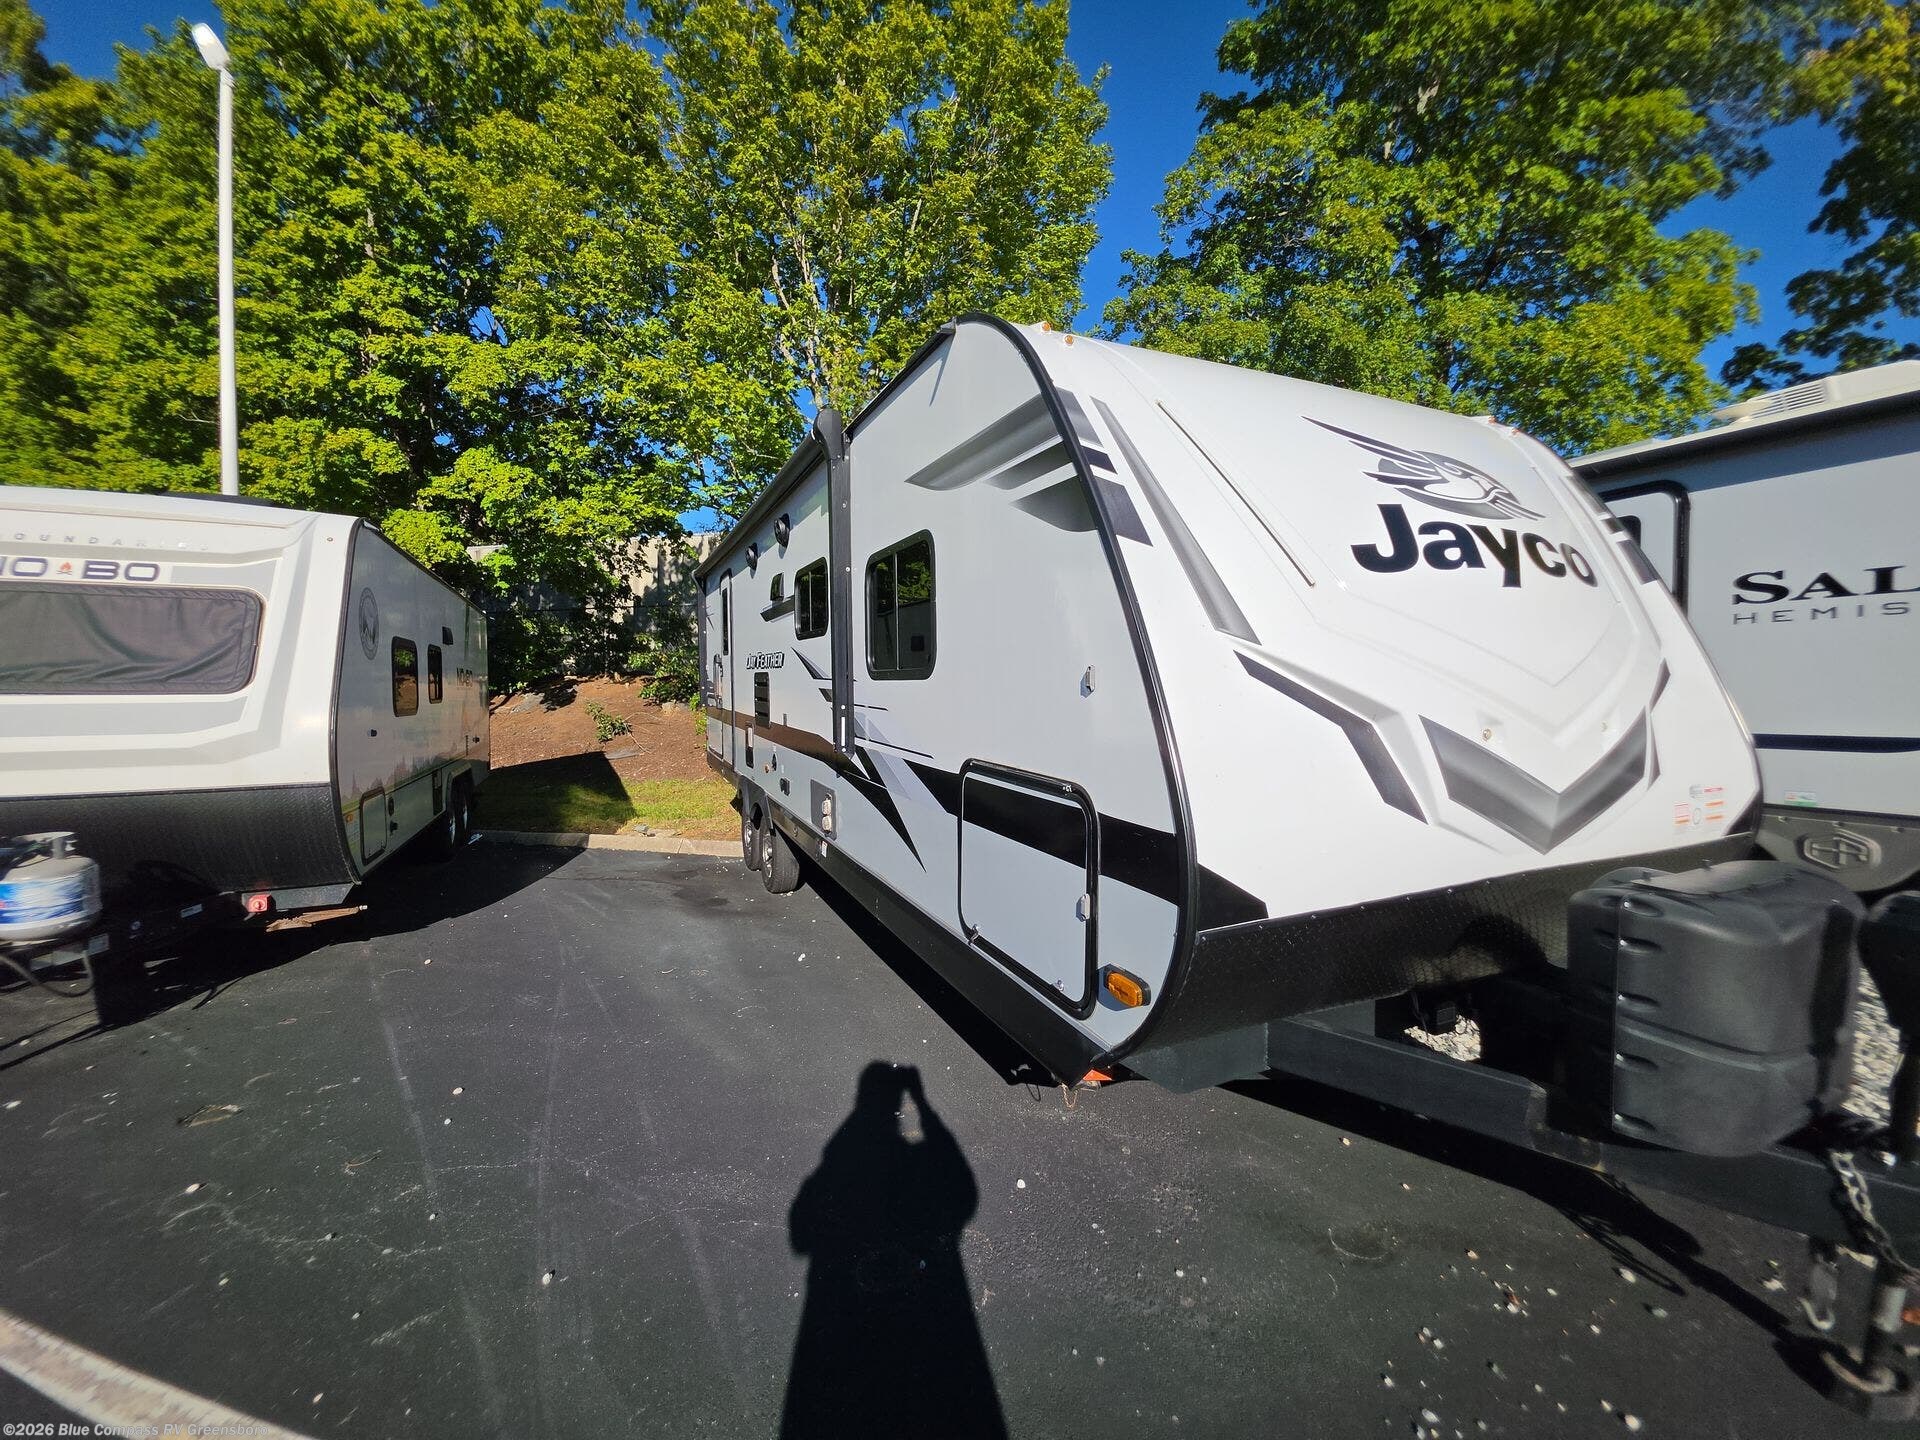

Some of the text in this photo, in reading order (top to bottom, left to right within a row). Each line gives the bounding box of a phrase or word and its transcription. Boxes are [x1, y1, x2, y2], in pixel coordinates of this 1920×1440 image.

[1350, 503, 1599, 588] Jayco
[81, 559, 160, 582] BO
[1732, 565, 1920, 605] SAL
[1733, 602, 1911, 625] HEMIS
